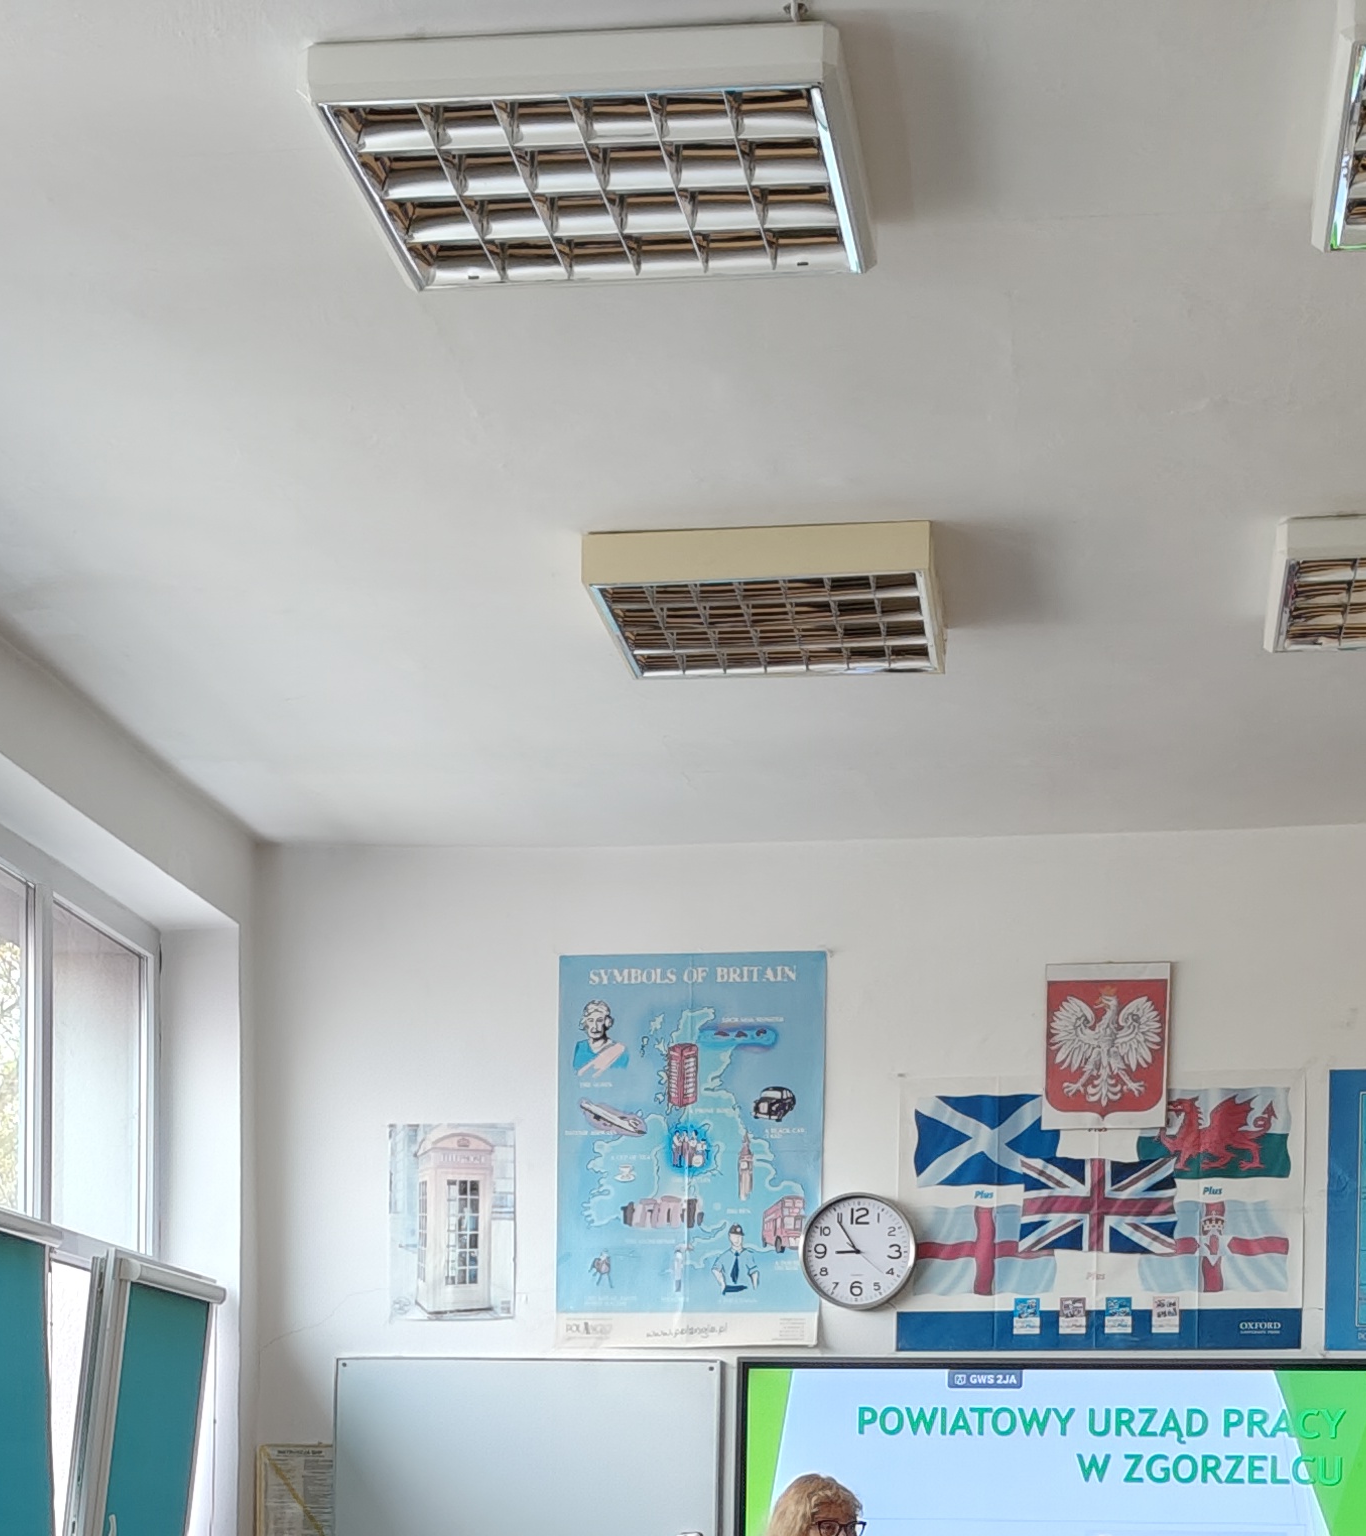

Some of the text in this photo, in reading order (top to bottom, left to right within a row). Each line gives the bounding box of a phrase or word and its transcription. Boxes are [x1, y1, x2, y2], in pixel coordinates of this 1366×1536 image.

[589, 966, 797, 985] SYMBOLS OF BRITAIN
[974, 1190, 994, 1200] Plus
[1202, 1186, 1223, 1196] Plus
[850, 1207, 870, 1225] 12
[877, 1213, 880, 1223] 1
[820, 1226, 831, 1236] 10
[887, 1226, 896, 1236] 2
[814, 1243, 827, 1259] 9
[887, 1244, 902, 1259] 3
[819, 1267, 828, 1276] 8
[886, 1267, 895, 1276] 4
[832, 1281, 839, 1291] 7
[850, 1281, 863, 1297] 6
[873, 1282, 881, 1291] 5
[1239, 1321, 1281, 1330] OXFORD
[970, 1374, 1017, 1385] GWS 2JA
[857, 1407, 1346, 1444] POWIATOWY URZĄD PRACY
[1077, 1453, 1344, 1487] W ZGORZELCU
